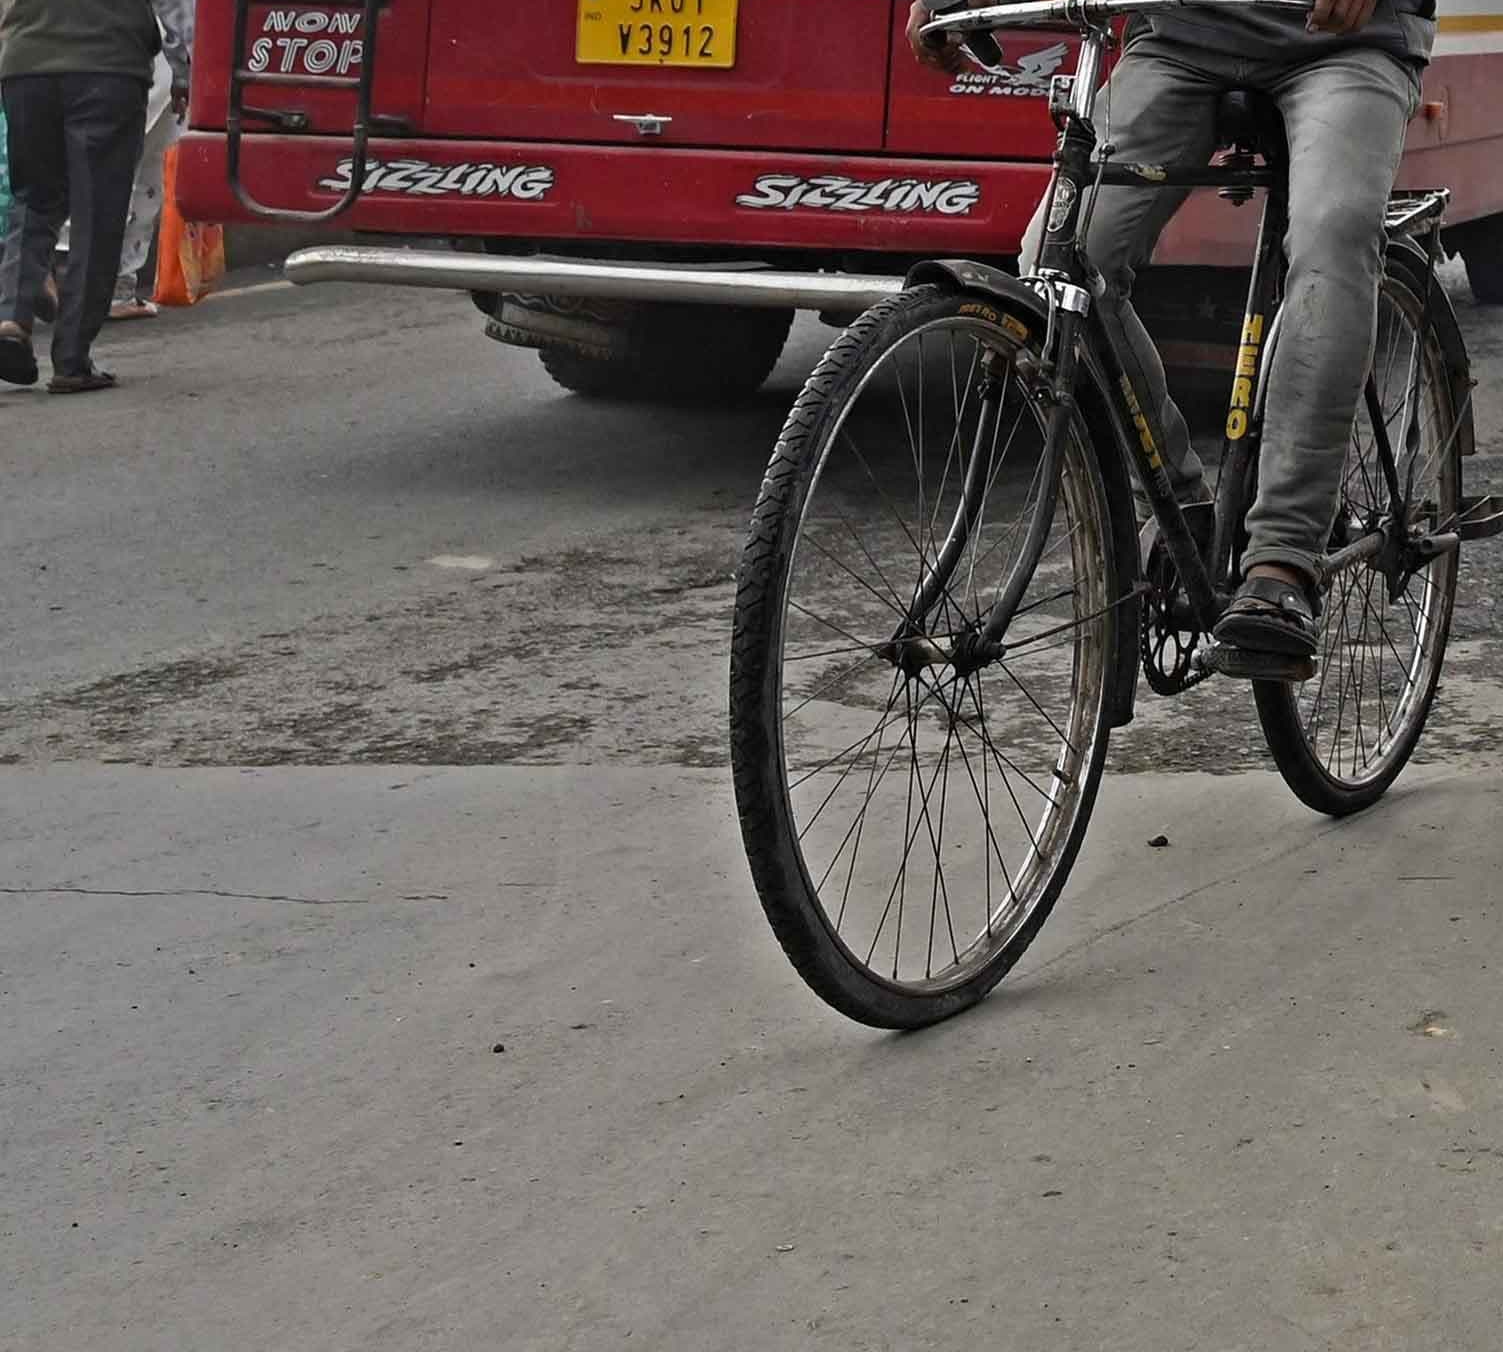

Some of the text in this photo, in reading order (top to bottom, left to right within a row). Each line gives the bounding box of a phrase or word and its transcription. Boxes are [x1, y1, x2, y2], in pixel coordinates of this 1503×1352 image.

[263, 10, 361, 34] NON
[618, 23, 714, 57] V3912
[248, 37, 364, 75] STOP
[950, 84, 1051, 97] ON MOD
[956, 73, 999, 85] FLIGHT
[319, 159, 553, 199] SIZZLING
[735, 175, 980, 214] SIZZLING
[1226, 312, 1264, 441] HERO
